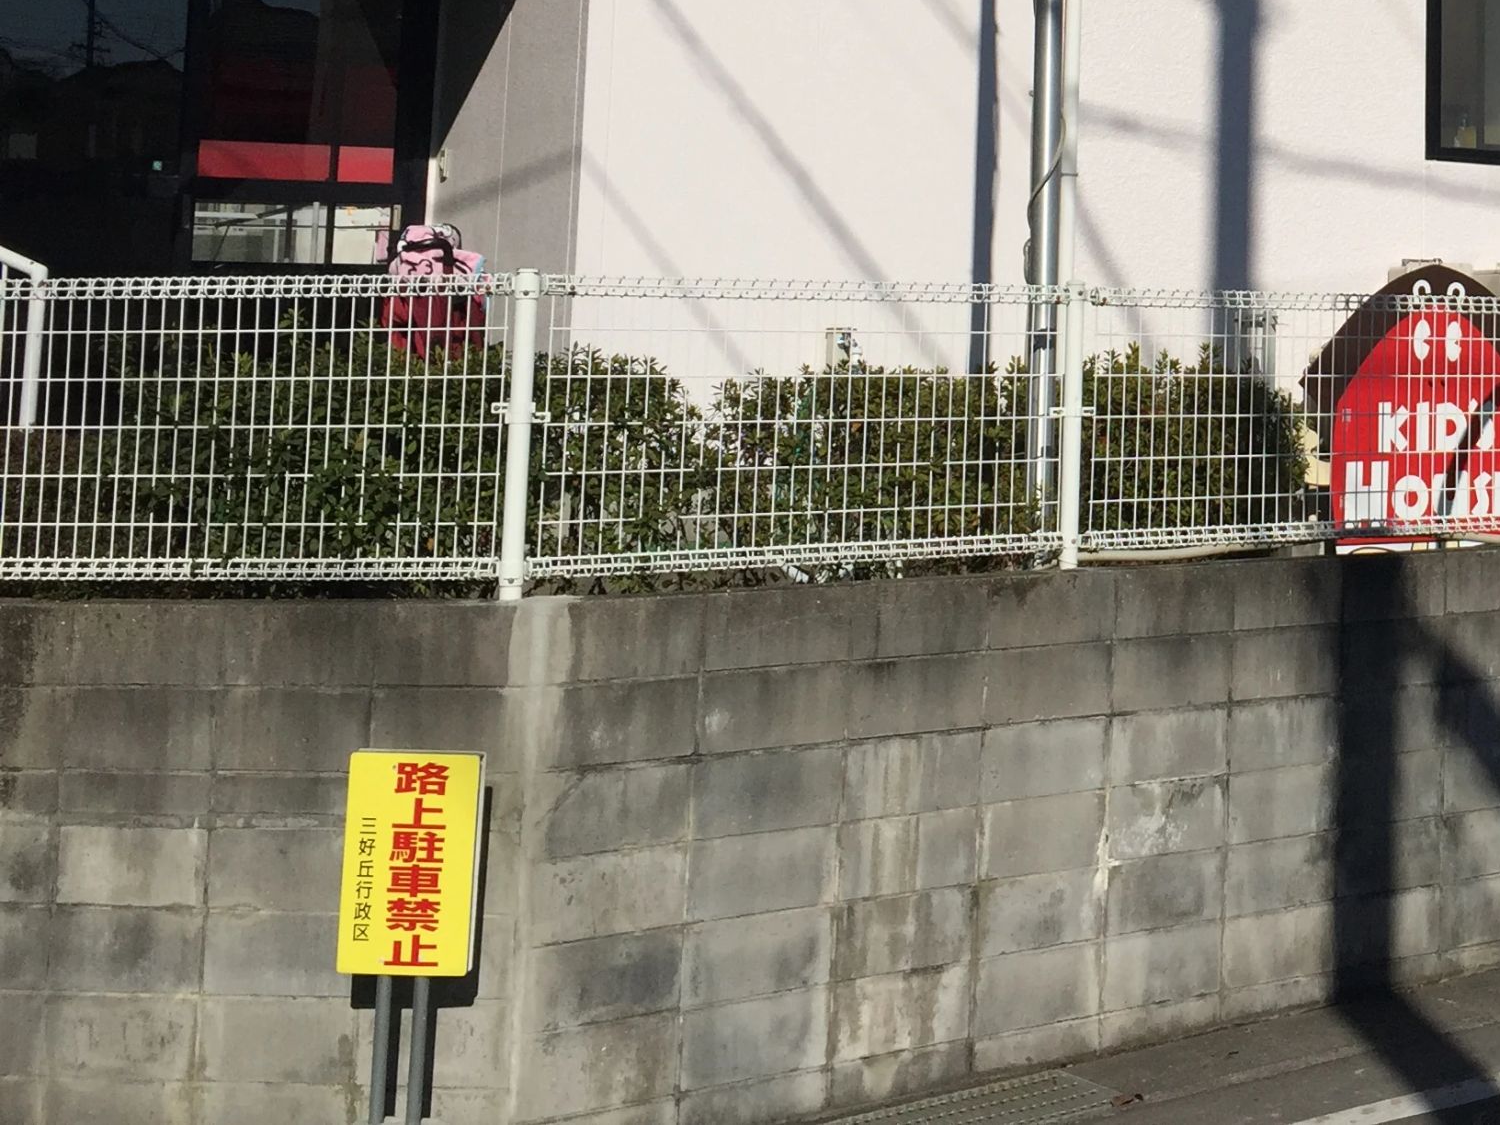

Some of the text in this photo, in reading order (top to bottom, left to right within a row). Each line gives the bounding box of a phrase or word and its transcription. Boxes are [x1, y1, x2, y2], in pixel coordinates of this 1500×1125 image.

[353, 817, 377, 941] 三好丘行政区
[384, 762, 449, 967] 路上駐車禁止
